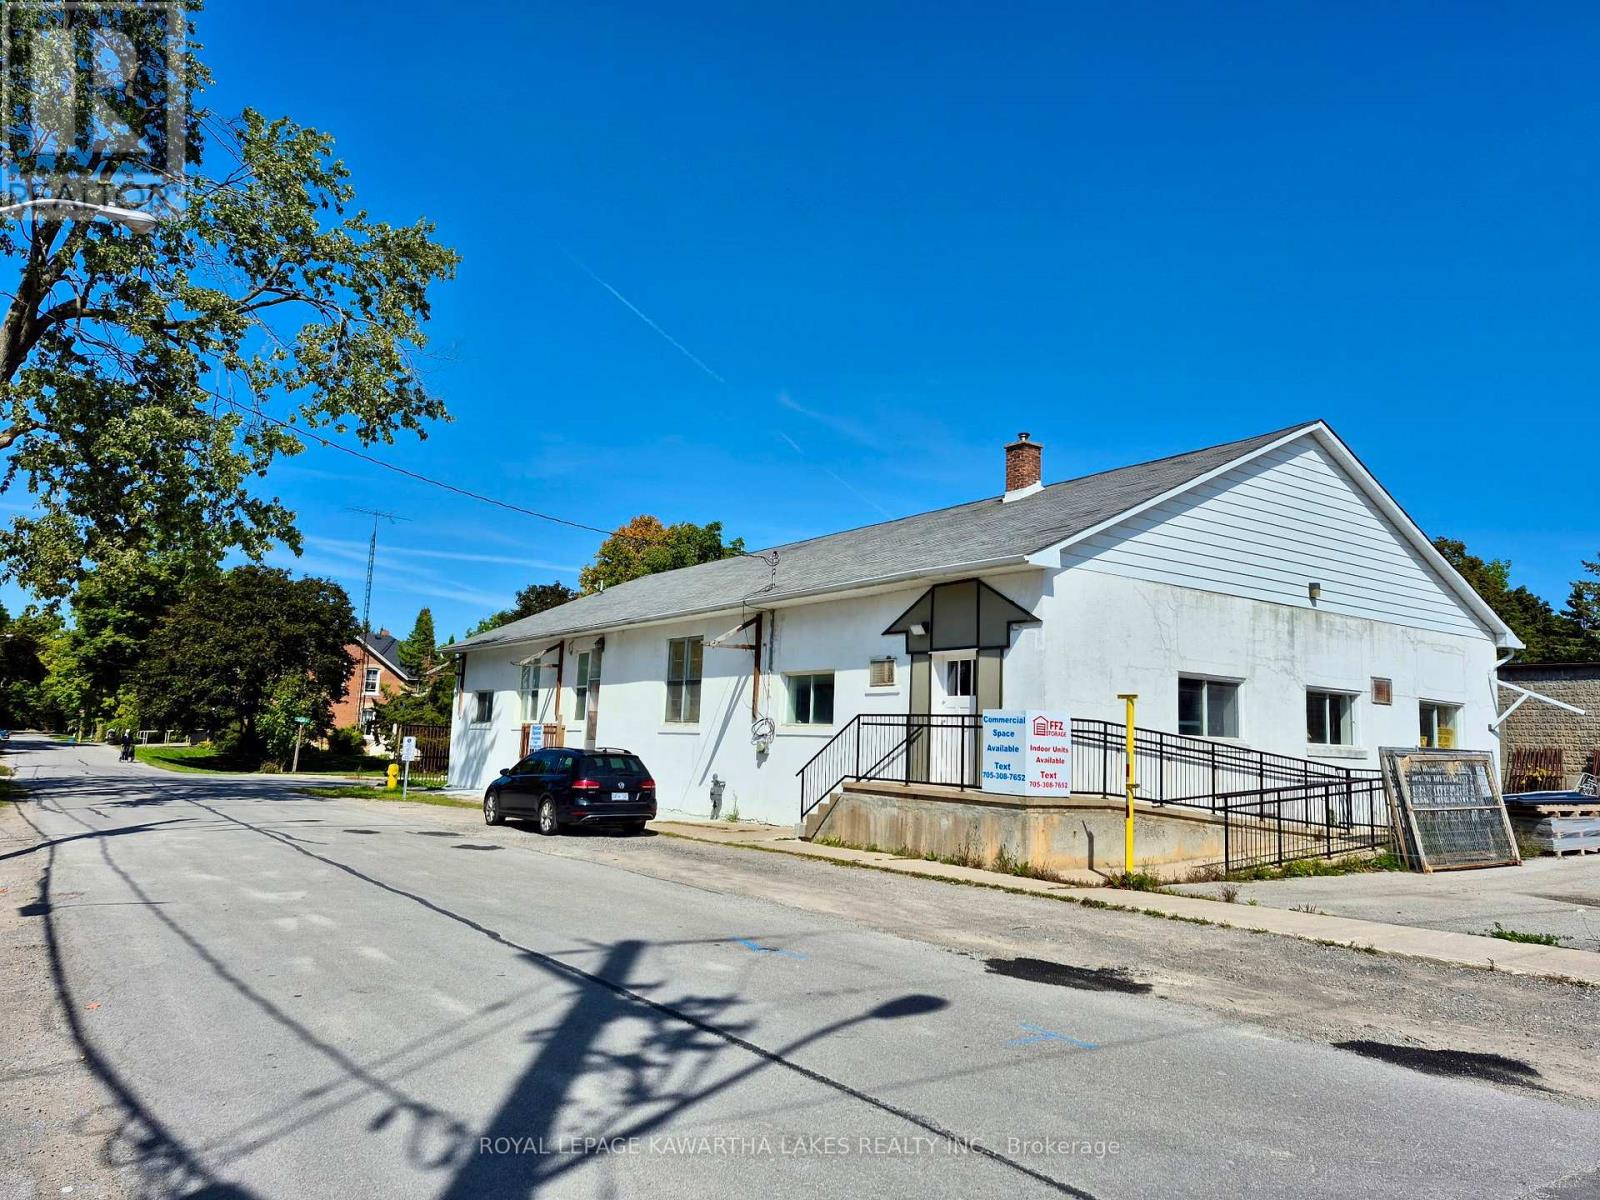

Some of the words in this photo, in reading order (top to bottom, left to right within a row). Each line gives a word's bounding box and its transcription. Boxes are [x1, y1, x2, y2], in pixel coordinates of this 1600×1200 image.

[983, 716, 1025, 724] Commercial
[1049, 721, 1064, 730] FFZ
[992, 729, 1015, 738] Space
[987, 744, 1019, 752] Available
[994, 762, 1011, 770] Text
[983, 772, 1026, 782] 705-308-7652
[1040, 771, 1057, 779] Text
